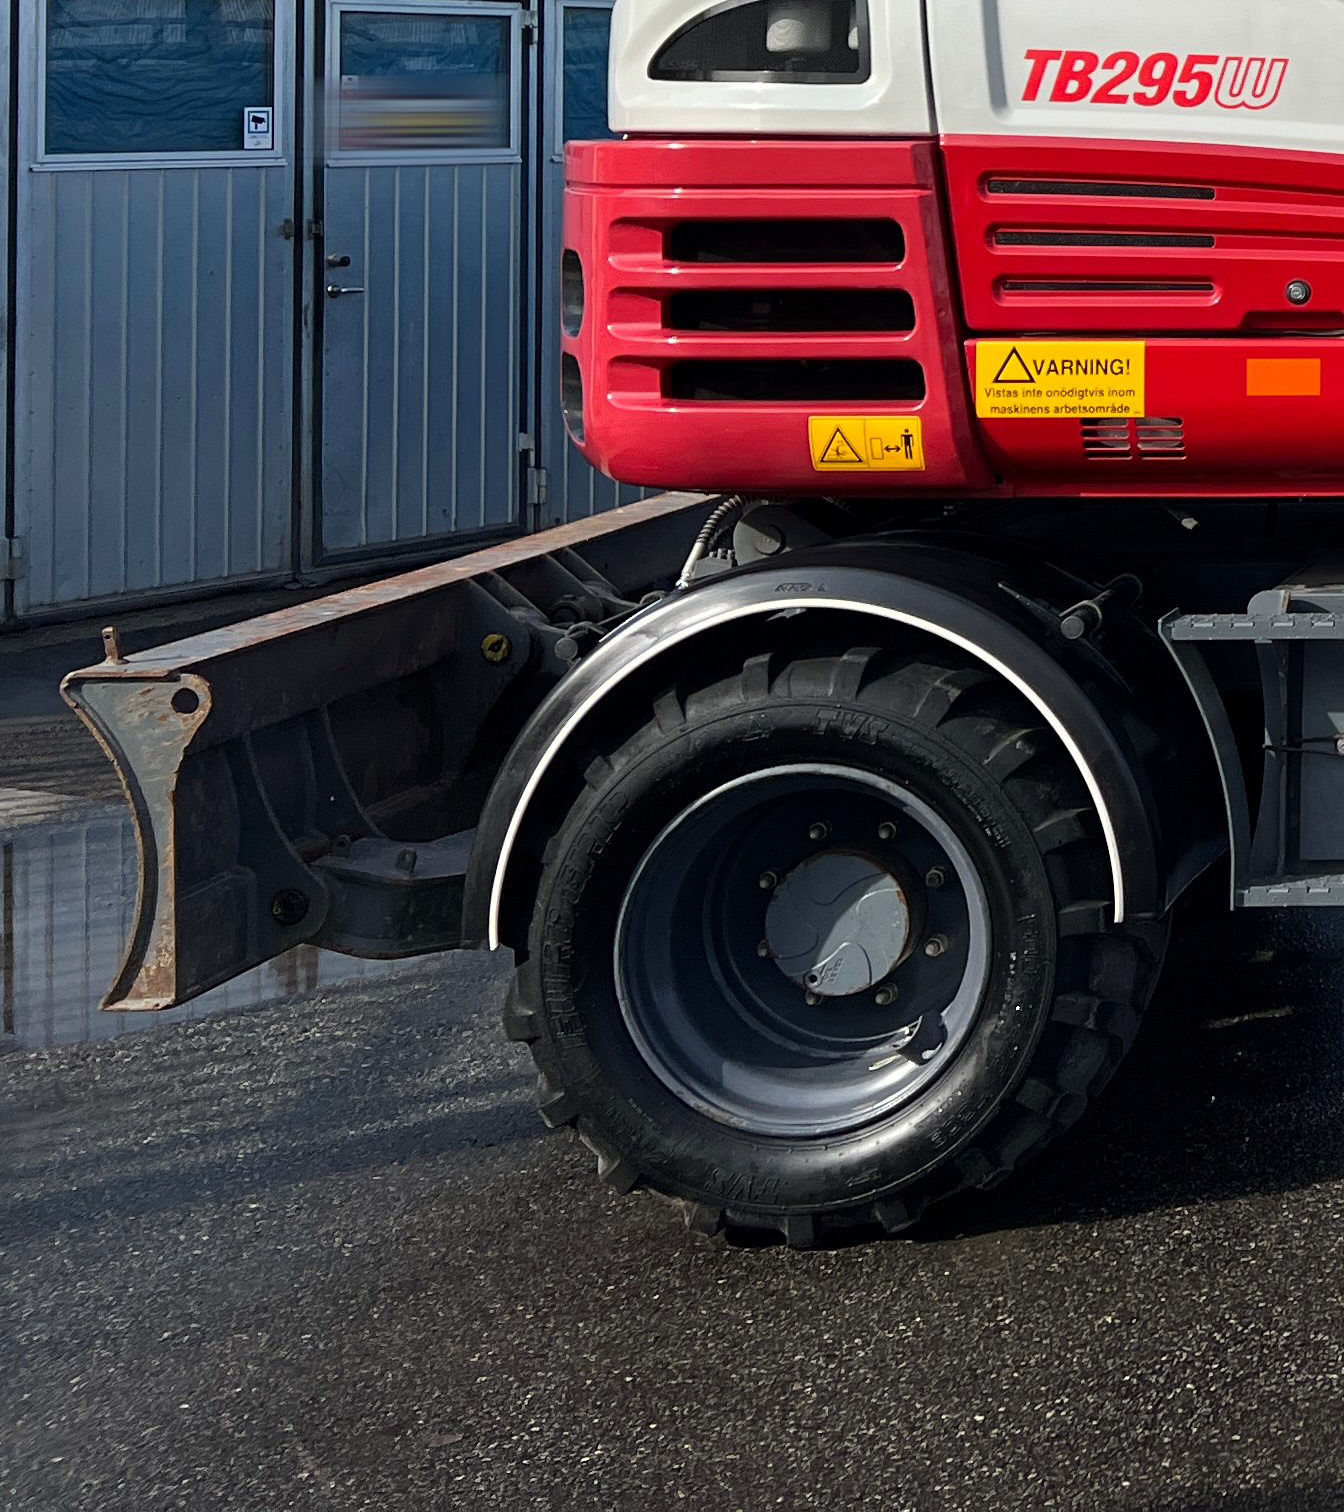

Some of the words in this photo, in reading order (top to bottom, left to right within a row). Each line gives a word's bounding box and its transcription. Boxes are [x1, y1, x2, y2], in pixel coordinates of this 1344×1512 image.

[1021, 49, 1289, 110] TB295W
[1033, 359, 1130, 376] VARNING!
[985, 388, 1019, 398] Vistas
[1022, 388, 1043, 398] inte
[1046, 387, 1105, 400] onödigtvis
[1107, 388, 1136, 398] inom
[990, 403, 1050, 414] maskinens
[1053, 402, 1131, 414] arbetsområde
